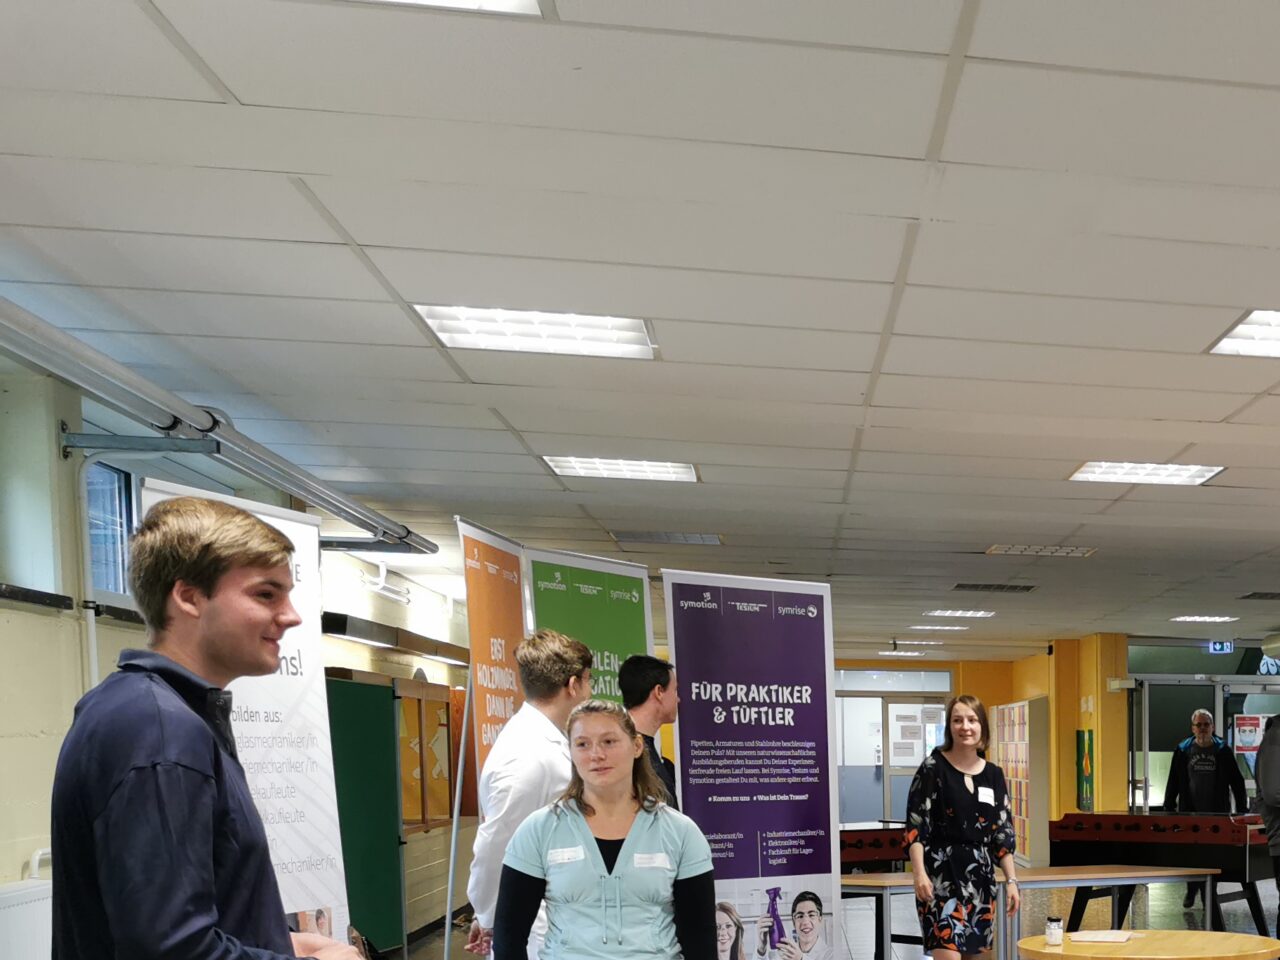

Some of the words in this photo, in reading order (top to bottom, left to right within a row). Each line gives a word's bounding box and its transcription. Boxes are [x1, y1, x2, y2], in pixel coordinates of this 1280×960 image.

[680, 600, 718, 610] symotion
[777, 606, 806, 616] symrise
[691, 681, 722, 702] FÜR
[726, 683, 812, 704] PRAKTIKER
[713, 706, 726, 724] &
[731, 705, 795, 727] TÜFTLER
[235, 732, 319, 753] glasmechaniker/in
